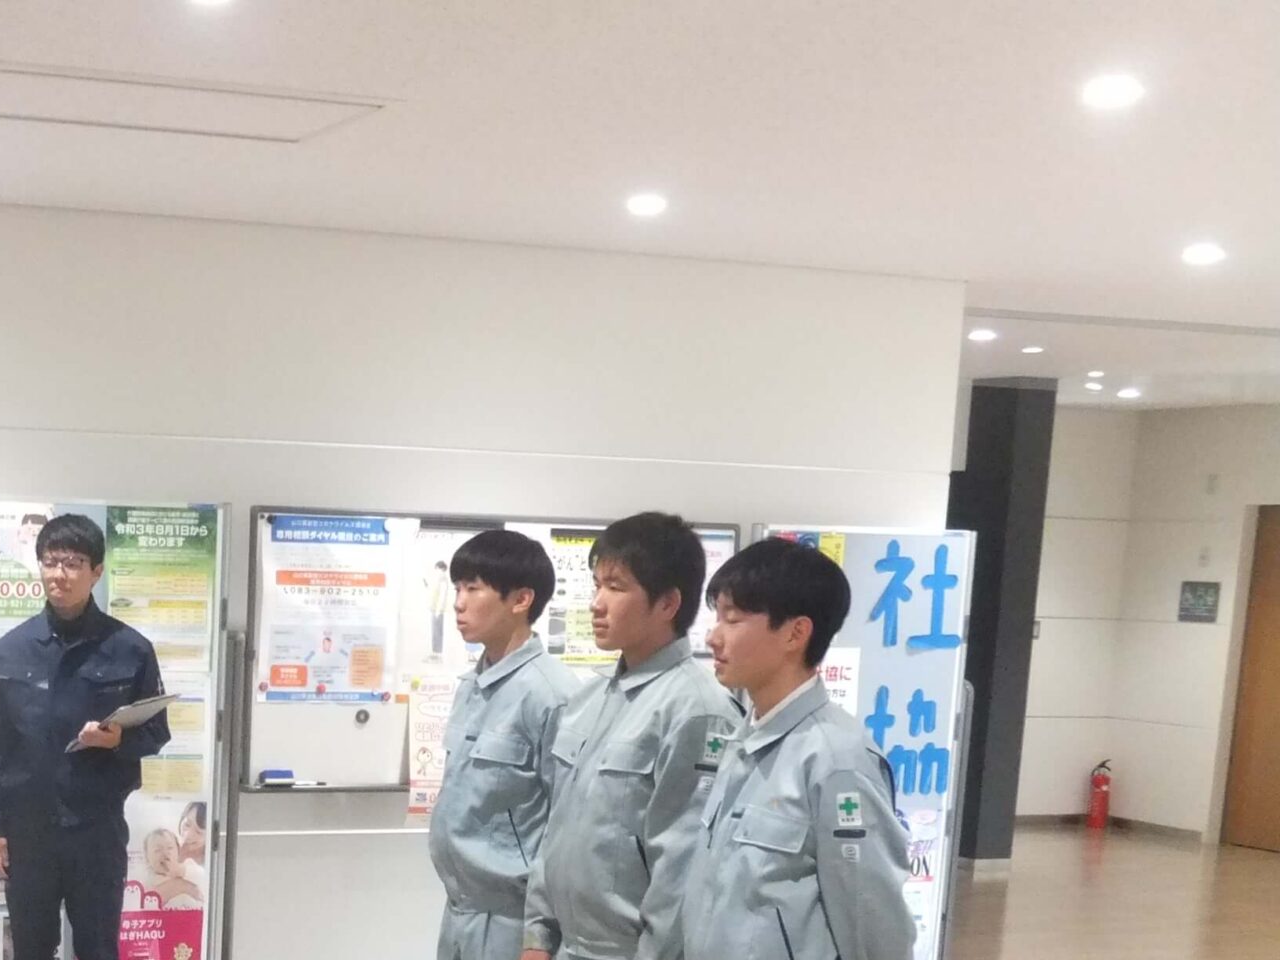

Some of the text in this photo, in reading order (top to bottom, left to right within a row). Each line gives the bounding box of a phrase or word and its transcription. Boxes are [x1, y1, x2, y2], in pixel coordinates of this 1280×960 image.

[114, 523, 208, 536] 令和3年8月1日から
[137, 536, 185, 547] 変わります
[122, 919, 163, 929] 母子アプリ
